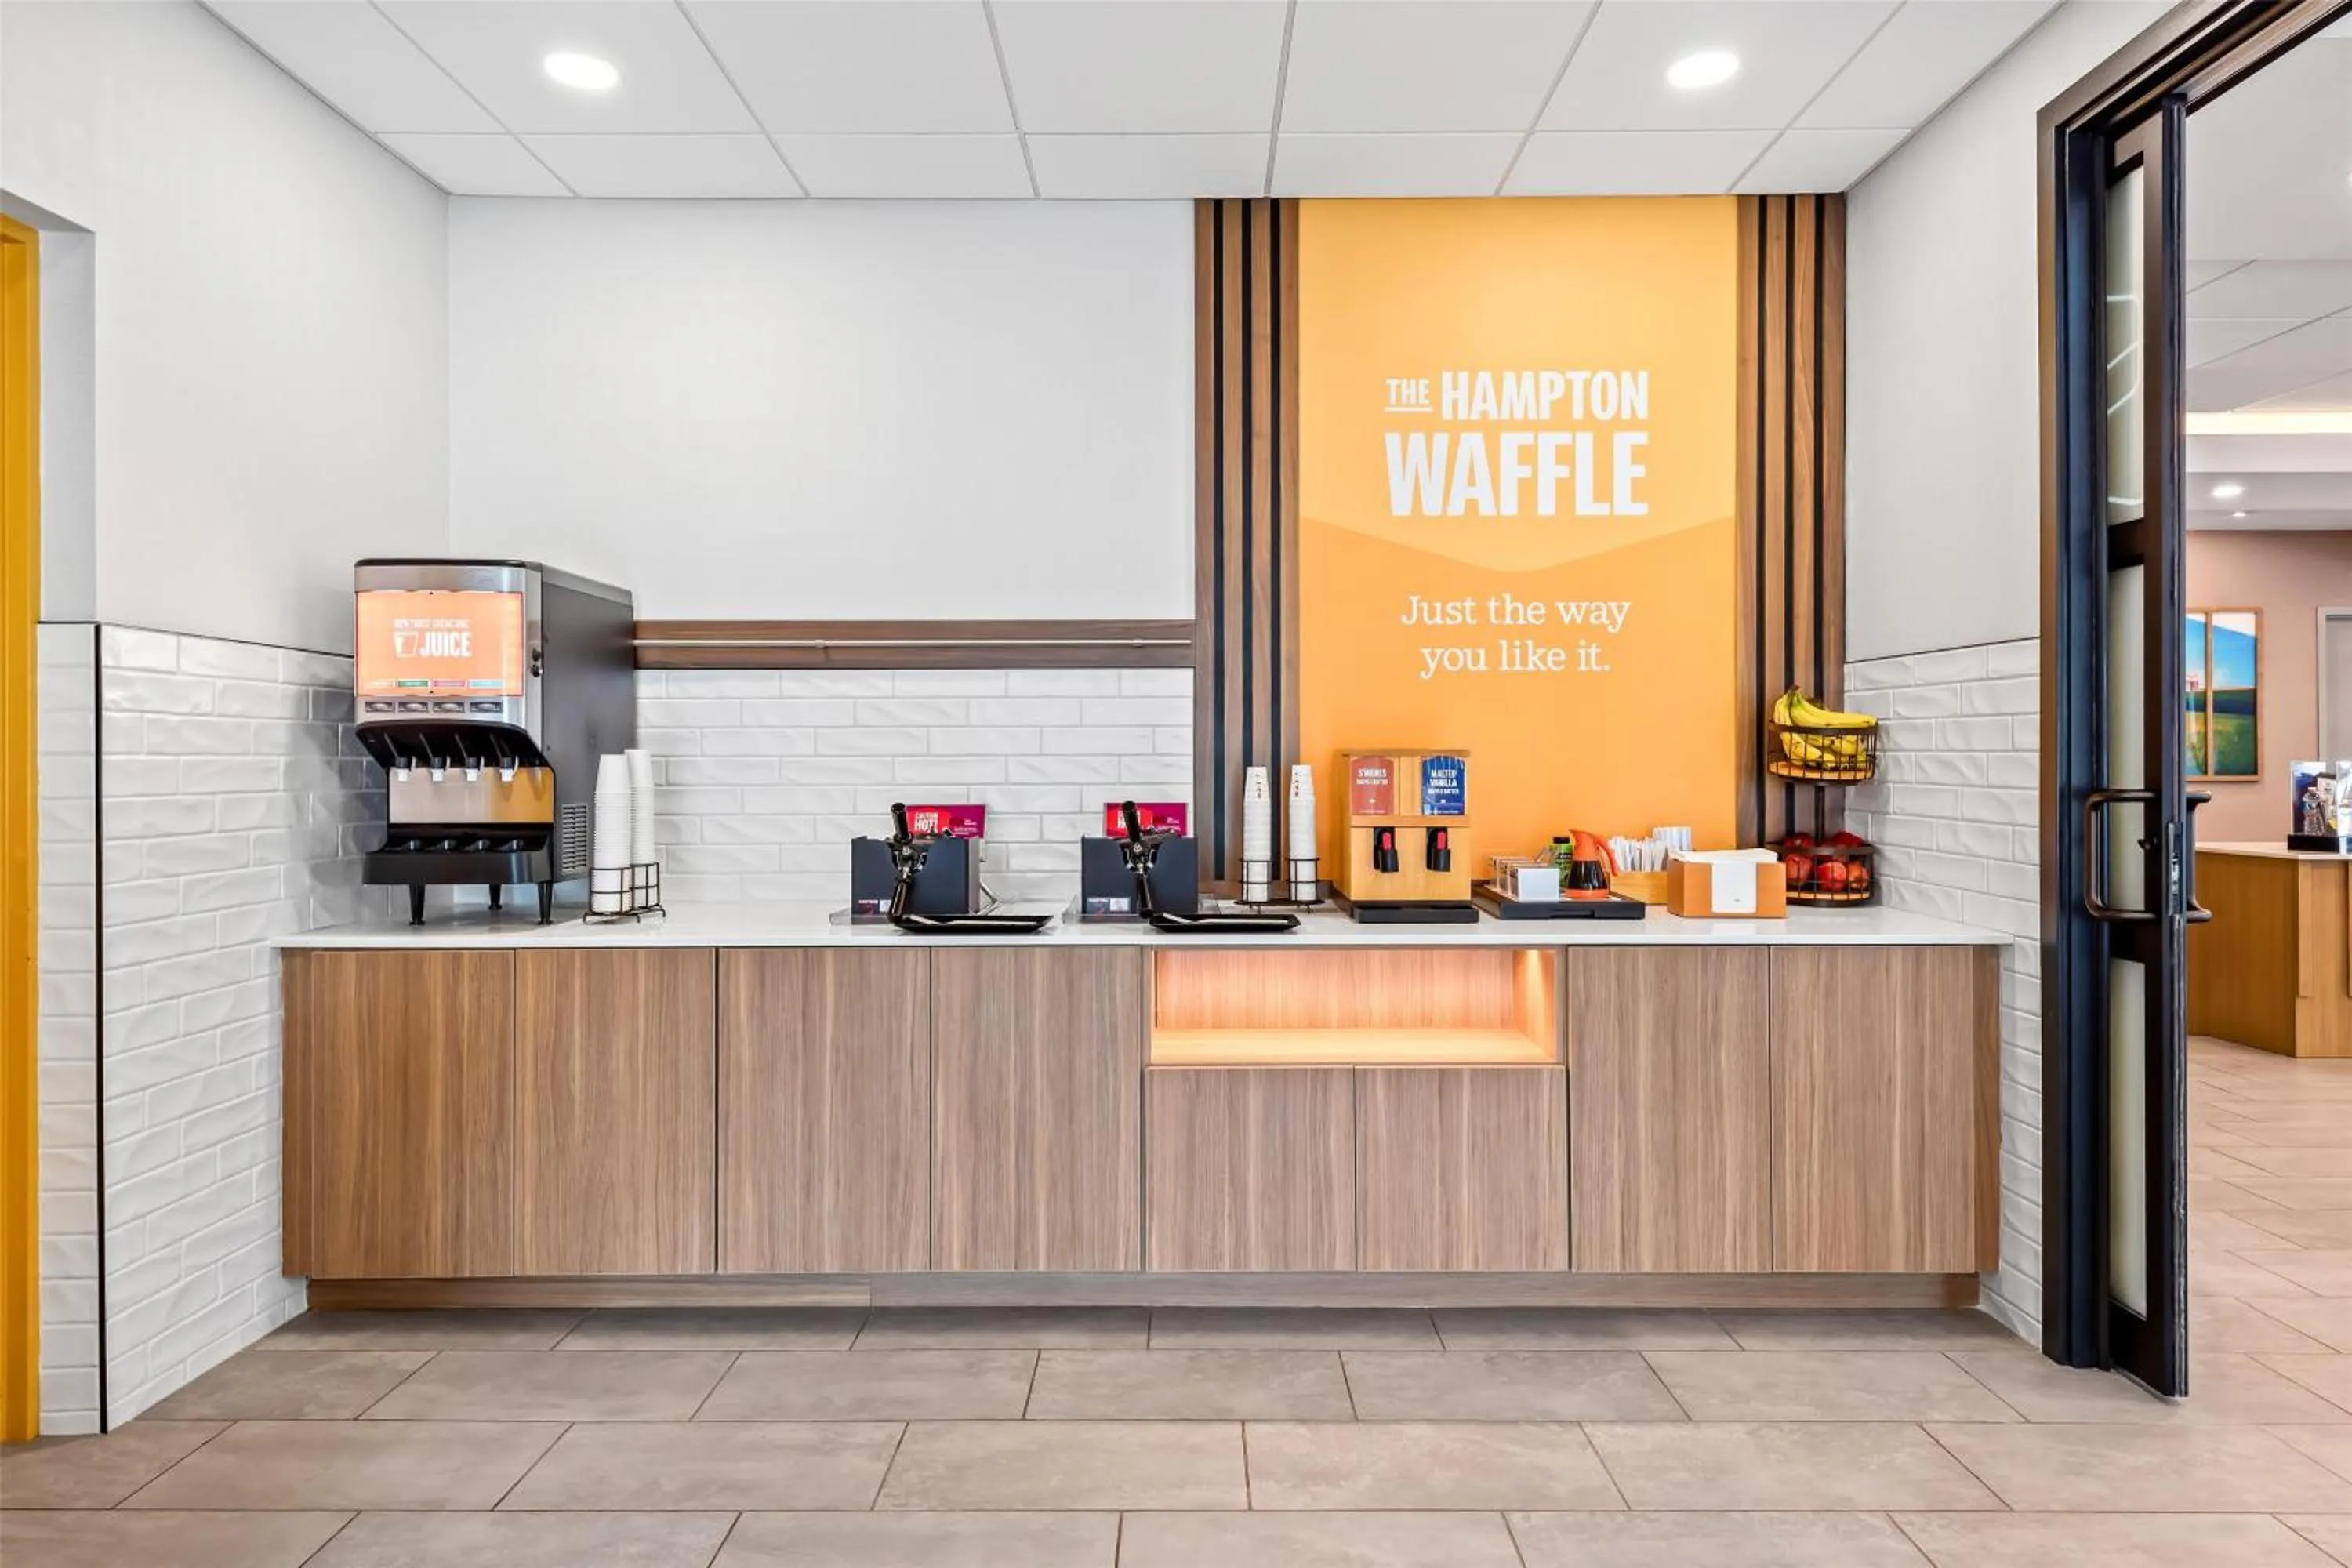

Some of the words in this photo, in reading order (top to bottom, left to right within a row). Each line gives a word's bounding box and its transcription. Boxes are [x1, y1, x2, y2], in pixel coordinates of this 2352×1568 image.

[1386, 379, 1430, 405] THE
[1441, 371, 1648, 420] HAMPTON
[1385, 431, 1649, 516] WAFFLE
[1401, 595, 1477, 625] Just
[1487, 593, 1546, 624] the
[1555, 600, 1632, 633] way
[420, 631, 473, 657] JUICE
[1420, 644, 1488, 678] you
[1499, 640, 1566, 671] like
[1577, 641, 1611, 671] it.
